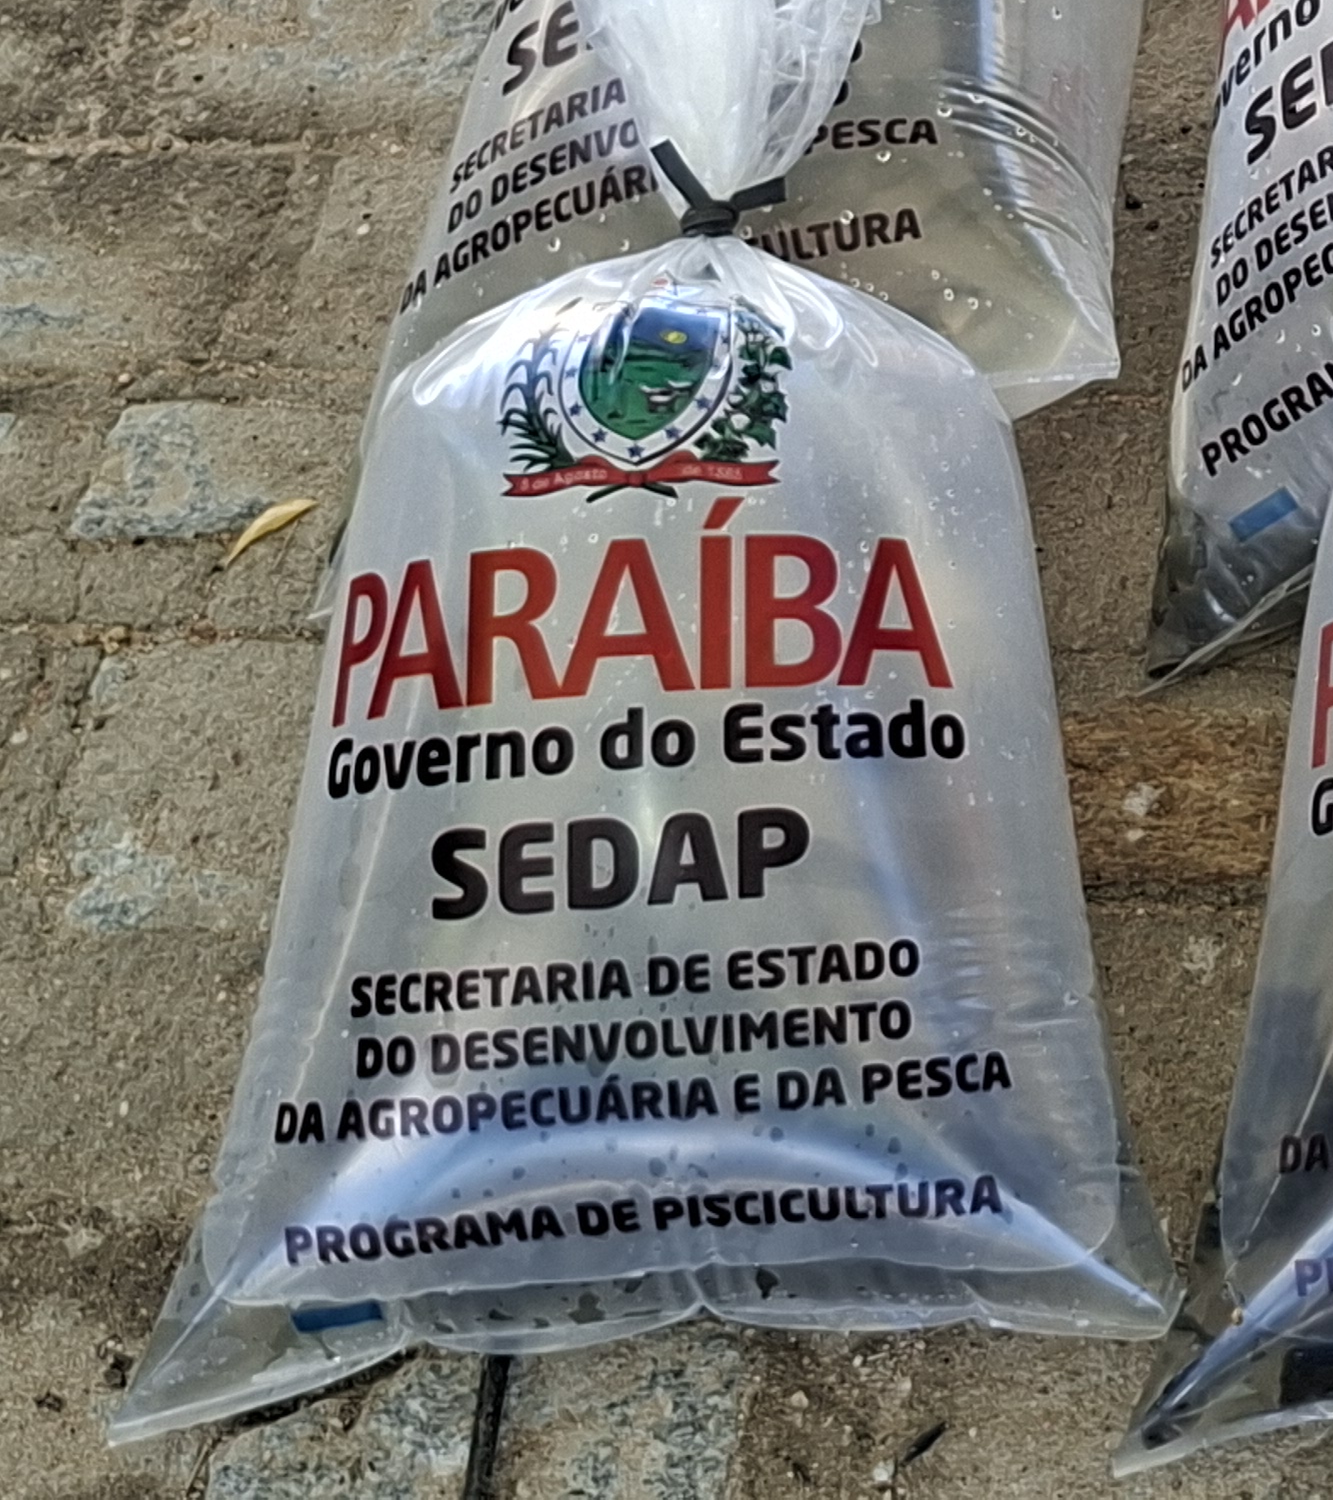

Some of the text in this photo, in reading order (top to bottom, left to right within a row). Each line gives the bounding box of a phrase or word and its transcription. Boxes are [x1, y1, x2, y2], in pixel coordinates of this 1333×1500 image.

[450, 77, 626, 194] SECRETARIA
[399, 269, 427, 315] DA
[433, 164, 659, 287] AGROPECUÁRI
[447, 188, 482, 234] DO
[1216, 257, 1249, 307] DO
[1181, 345, 1208, 393] DA
[330, 499, 953, 728] PARAÍBA
[326, 699, 965, 799] Governo do Estado
[430, 806, 811, 920] SEDAP
[350, 938, 920, 1019] SECRETARIA DE ESTADO
[355, 999, 912, 1079] DO DESENVOLVIMENTO
[275, 1052, 1011, 1145] DA AGROPECUÁRIA E DA PESCA
[1278, 1133, 1331, 1177] DA
[283, 1174, 1001, 1265] PROGRAMA DE PISCICULTURA
